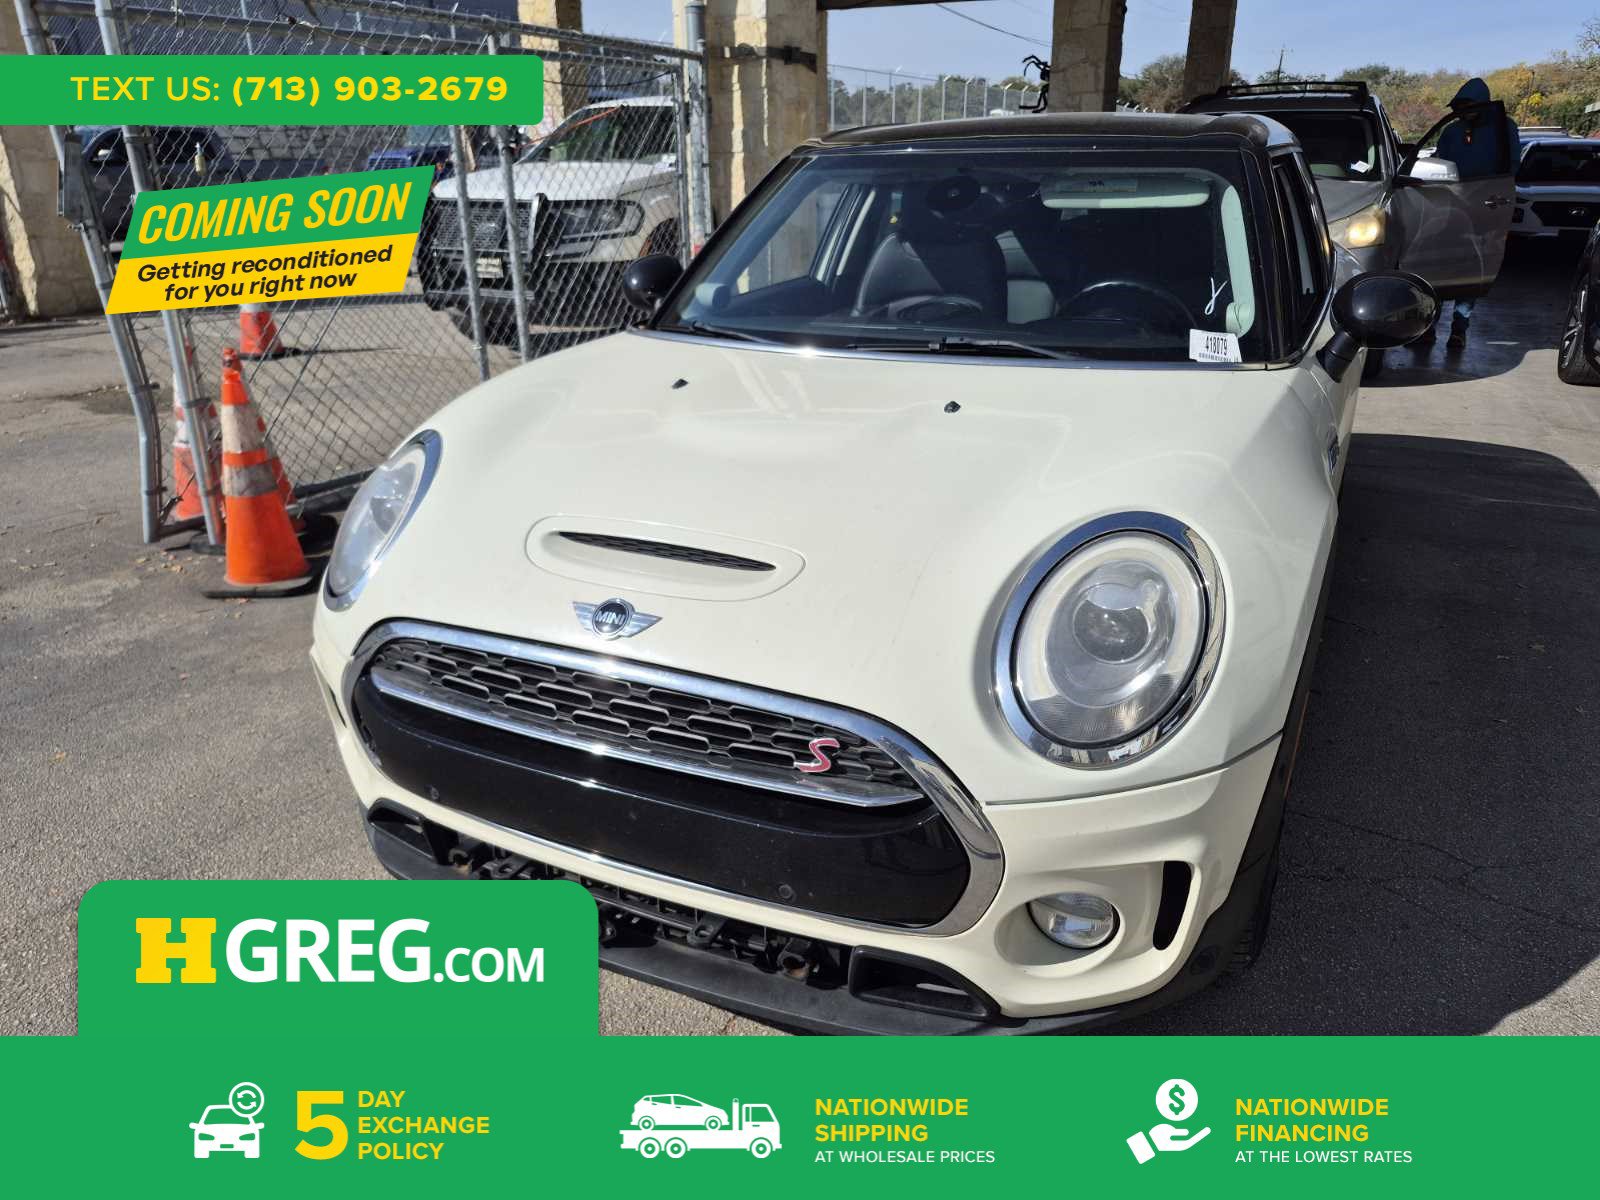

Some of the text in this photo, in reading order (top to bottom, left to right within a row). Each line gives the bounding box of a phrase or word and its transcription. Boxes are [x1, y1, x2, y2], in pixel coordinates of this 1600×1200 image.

[1205, 335, 1228, 356] 418079
[596, 610, 626, 626] MINI
[793, 737, 841, 773] S
